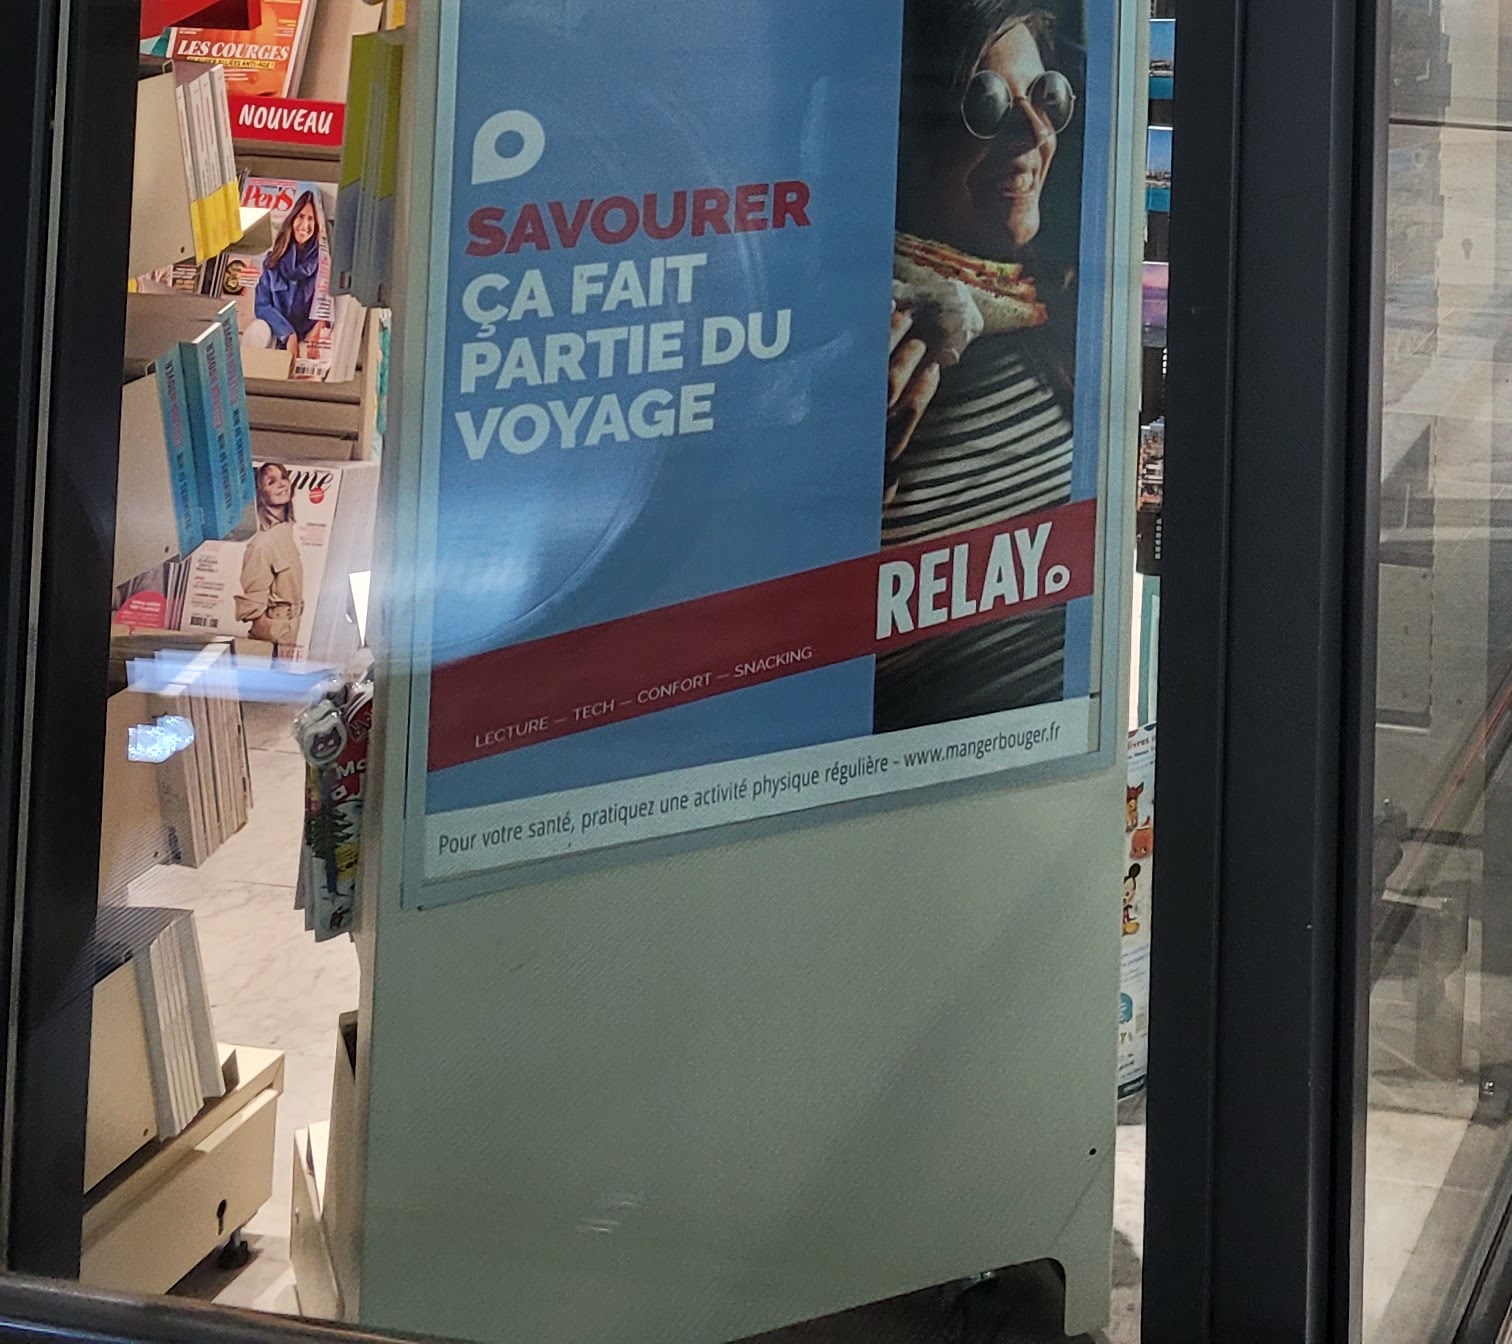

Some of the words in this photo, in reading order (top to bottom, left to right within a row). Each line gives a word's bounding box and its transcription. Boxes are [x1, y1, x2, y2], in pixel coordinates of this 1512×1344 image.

[177, 39, 212, 56] LES
[211, 41, 290, 62] COURGES
[238, 104, 334, 135] NOUVEAU
[464, 180, 812, 257] SAVOURER
[461, 268, 554, 339] ÇA
[571, 252, 709, 315] FAIT
[459, 319, 686, 395] PARTIE
[701, 308, 793, 367] DU
[454, 382, 717, 461] VOYAGE
[874, 520, 1055, 641] RELAY
[474, 715, 550, 749] LECTURE
[572, 698, 616, 722] TECH
[636, 670, 712, 705] CONFORT
[733, 645, 813, 678] SNACKING
[438, 833, 477, 856] Pour
[481, 823, 523, 847] votre
[527, 810, 575, 840] santé,
[580, 798, 656, 833] pratiquez
[659, 793, 690, 814] une
[693, 777, 749, 808] activité
[752, 767, 820, 802] physique
[824, 754, 889, 786] régulière
[903, 720, 1062, 769] www.mangerbouger.fr
